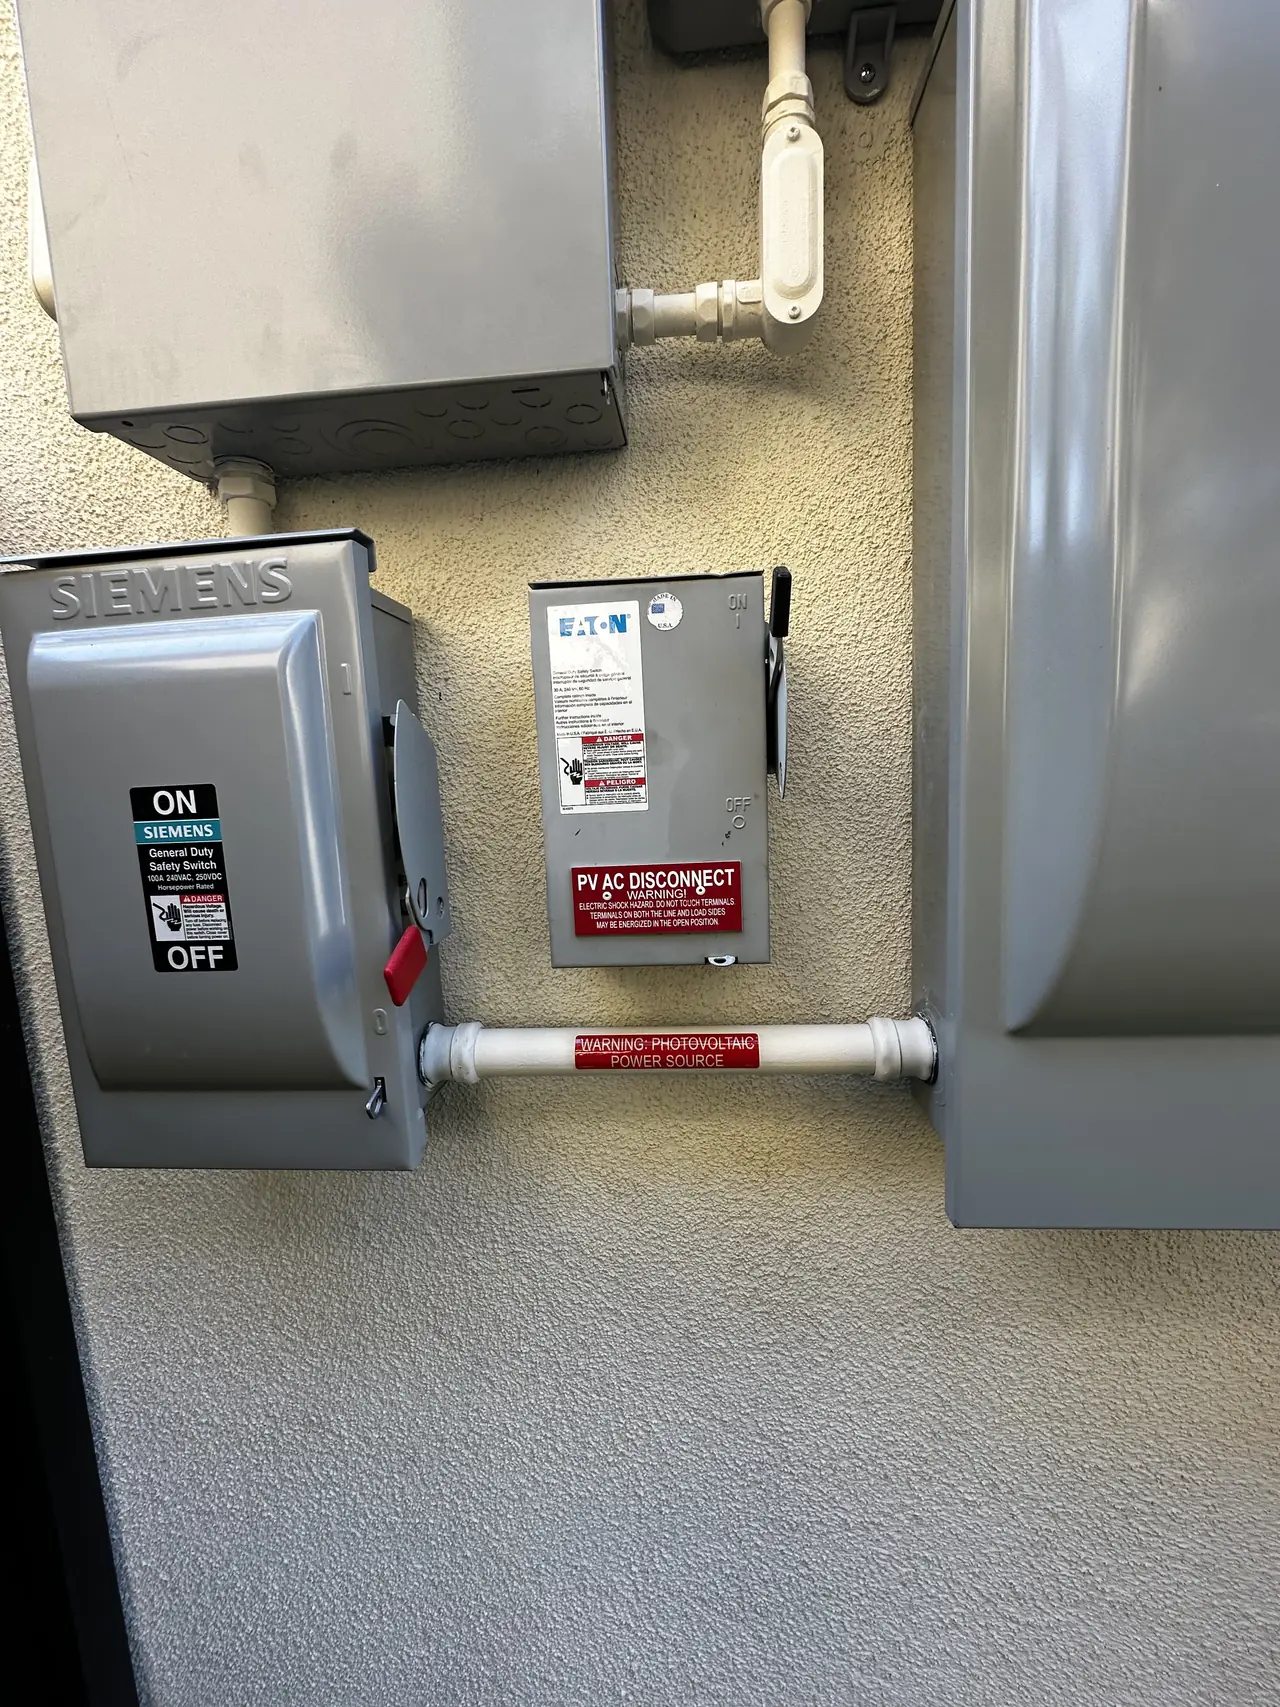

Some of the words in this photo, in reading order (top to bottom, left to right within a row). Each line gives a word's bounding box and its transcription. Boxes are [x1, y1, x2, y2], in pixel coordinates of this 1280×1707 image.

[50, 557, 292, 620] SIEMENS
[652, 594, 669, 602] MADE
[728, 593, 748, 610] ON
[153, 790, 197, 815] ON
[726, 797, 750, 812] OFF
[144, 824, 213, 839] SIEMENS
[149, 848, 188, 858] General
[190, 847, 214, 859] Duty
[149, 862, 180, 872] Safety
[183, 860, 217, 871] Switch
[166, 873, 194, 882] 240VAC,
[578, 874, 598, 890] PV
[602, 873, 624, 890] AC
[629, 869, 735, 889] DISCONNECT
[627, 889, 686, 900] WARNING!
[579, 902, 607, 910] ELECTRIC
[608, 901, 629, 909] SHOCK
[655, 900, 665, 908] DO
[679, 899, 700, 907] TOUCH
[590, 911, 623, 920] TERMINALS
[623, 910, 633, 918] ON
[634, 910, 650, 918] BOTH
[691, 908, 707, 916] LOAD
[596, 920, 608, 929] MAY
[609, 920, 618, 928] BE
[618, 920, 652, 928] ENERGIZED
[673, 918, 689, 926] OPEN
[168, 946, 224, 970] OFF
[581, 1038, 648, 1052] WARNING:
[652, 1036, 755, 1051] PHOTOVOLTAIC
[611, 1055, 662, 1068] POWER
[666, 1054, 724, 1067] SOURCE
